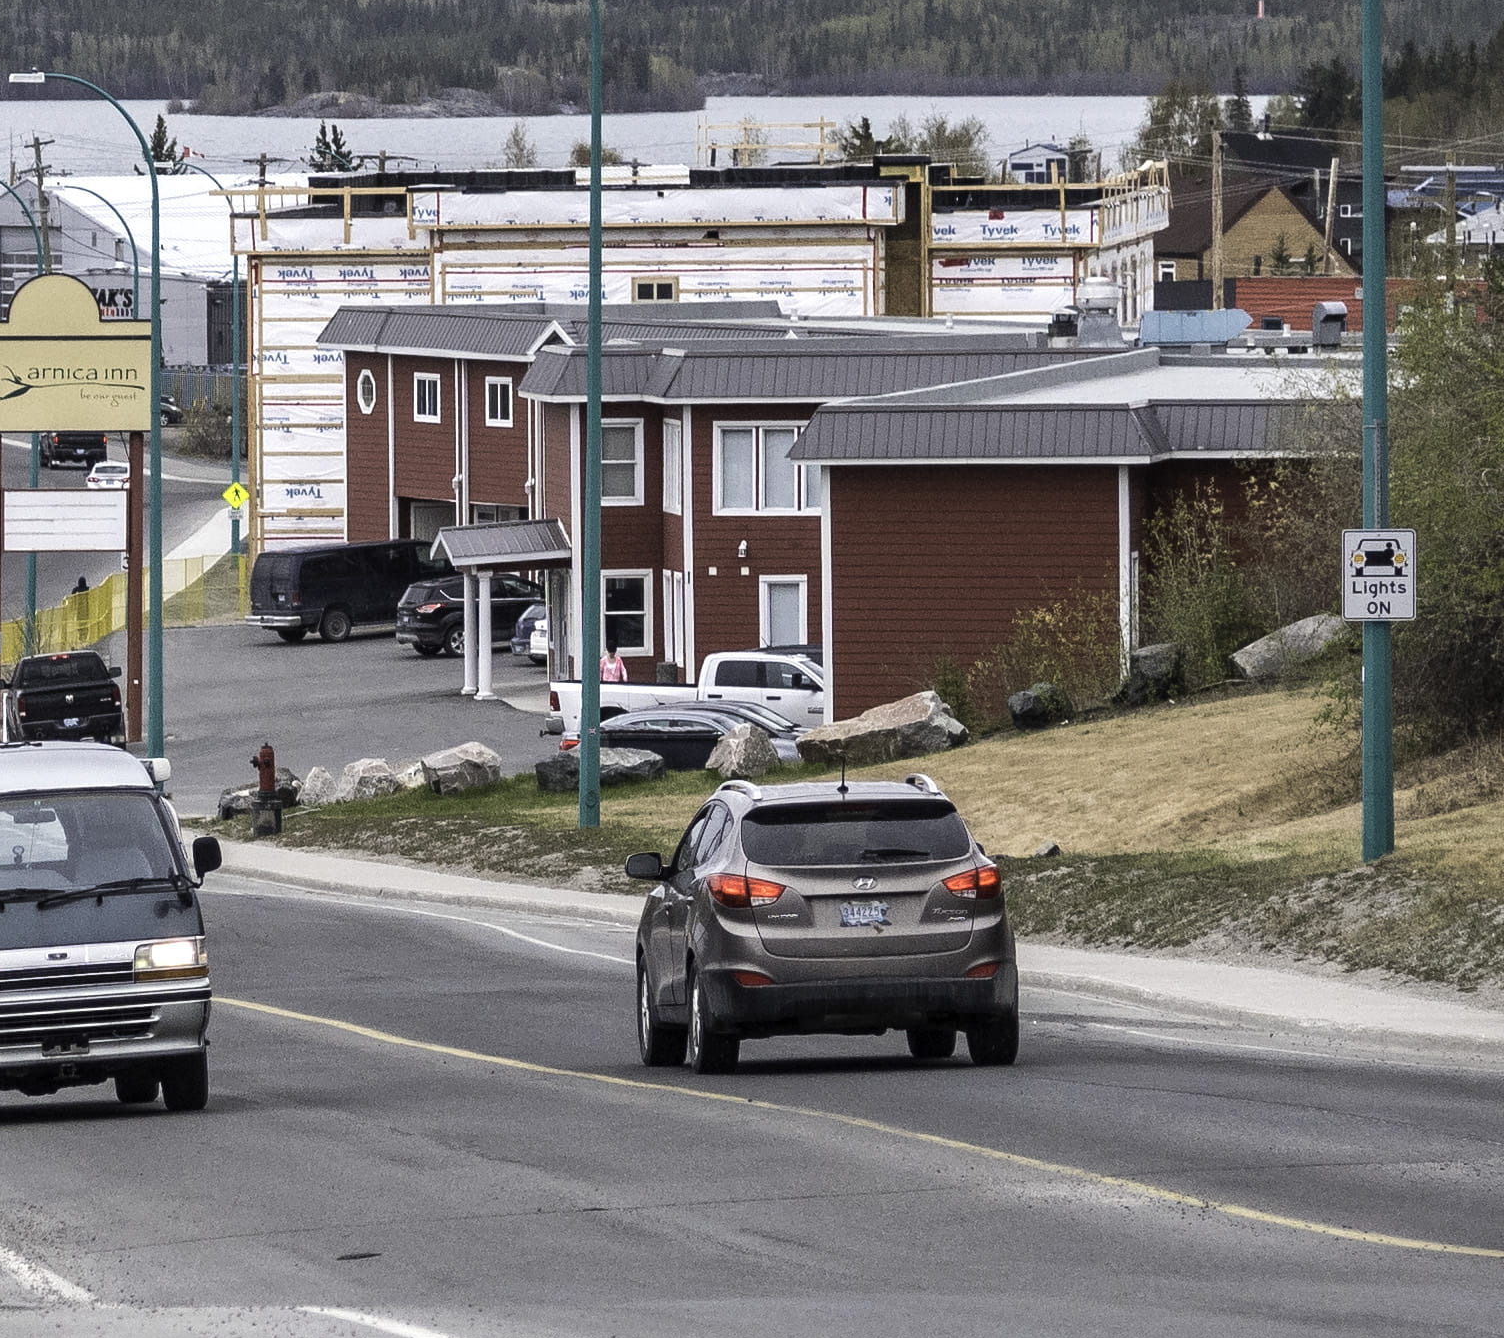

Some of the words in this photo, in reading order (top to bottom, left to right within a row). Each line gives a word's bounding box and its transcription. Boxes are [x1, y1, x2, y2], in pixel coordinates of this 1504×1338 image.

[934, 225, 956, 236] vek
[980, 224, 1019, 237] Tyvek
[278, 267, 315, 280] Tyvek
[338, 267, 376, 280] Tyvek
[399, 267, 429, 279] yvek
[91, 288, 133, 308] AK'S
[569, 289, 608, 301] Tvek
[313, 353, 343, 365] yvek
[27, 367, 98, 380] arnica
[104, 367, 137, 380] inn
[80, 388, 91, 400] be
[110, 391, 136, 407] guest
[286, 485, 323, 499] Tyvek
[1352, 580, 1406, 599] Lights
[1367, 601, 1390, 615] ON
